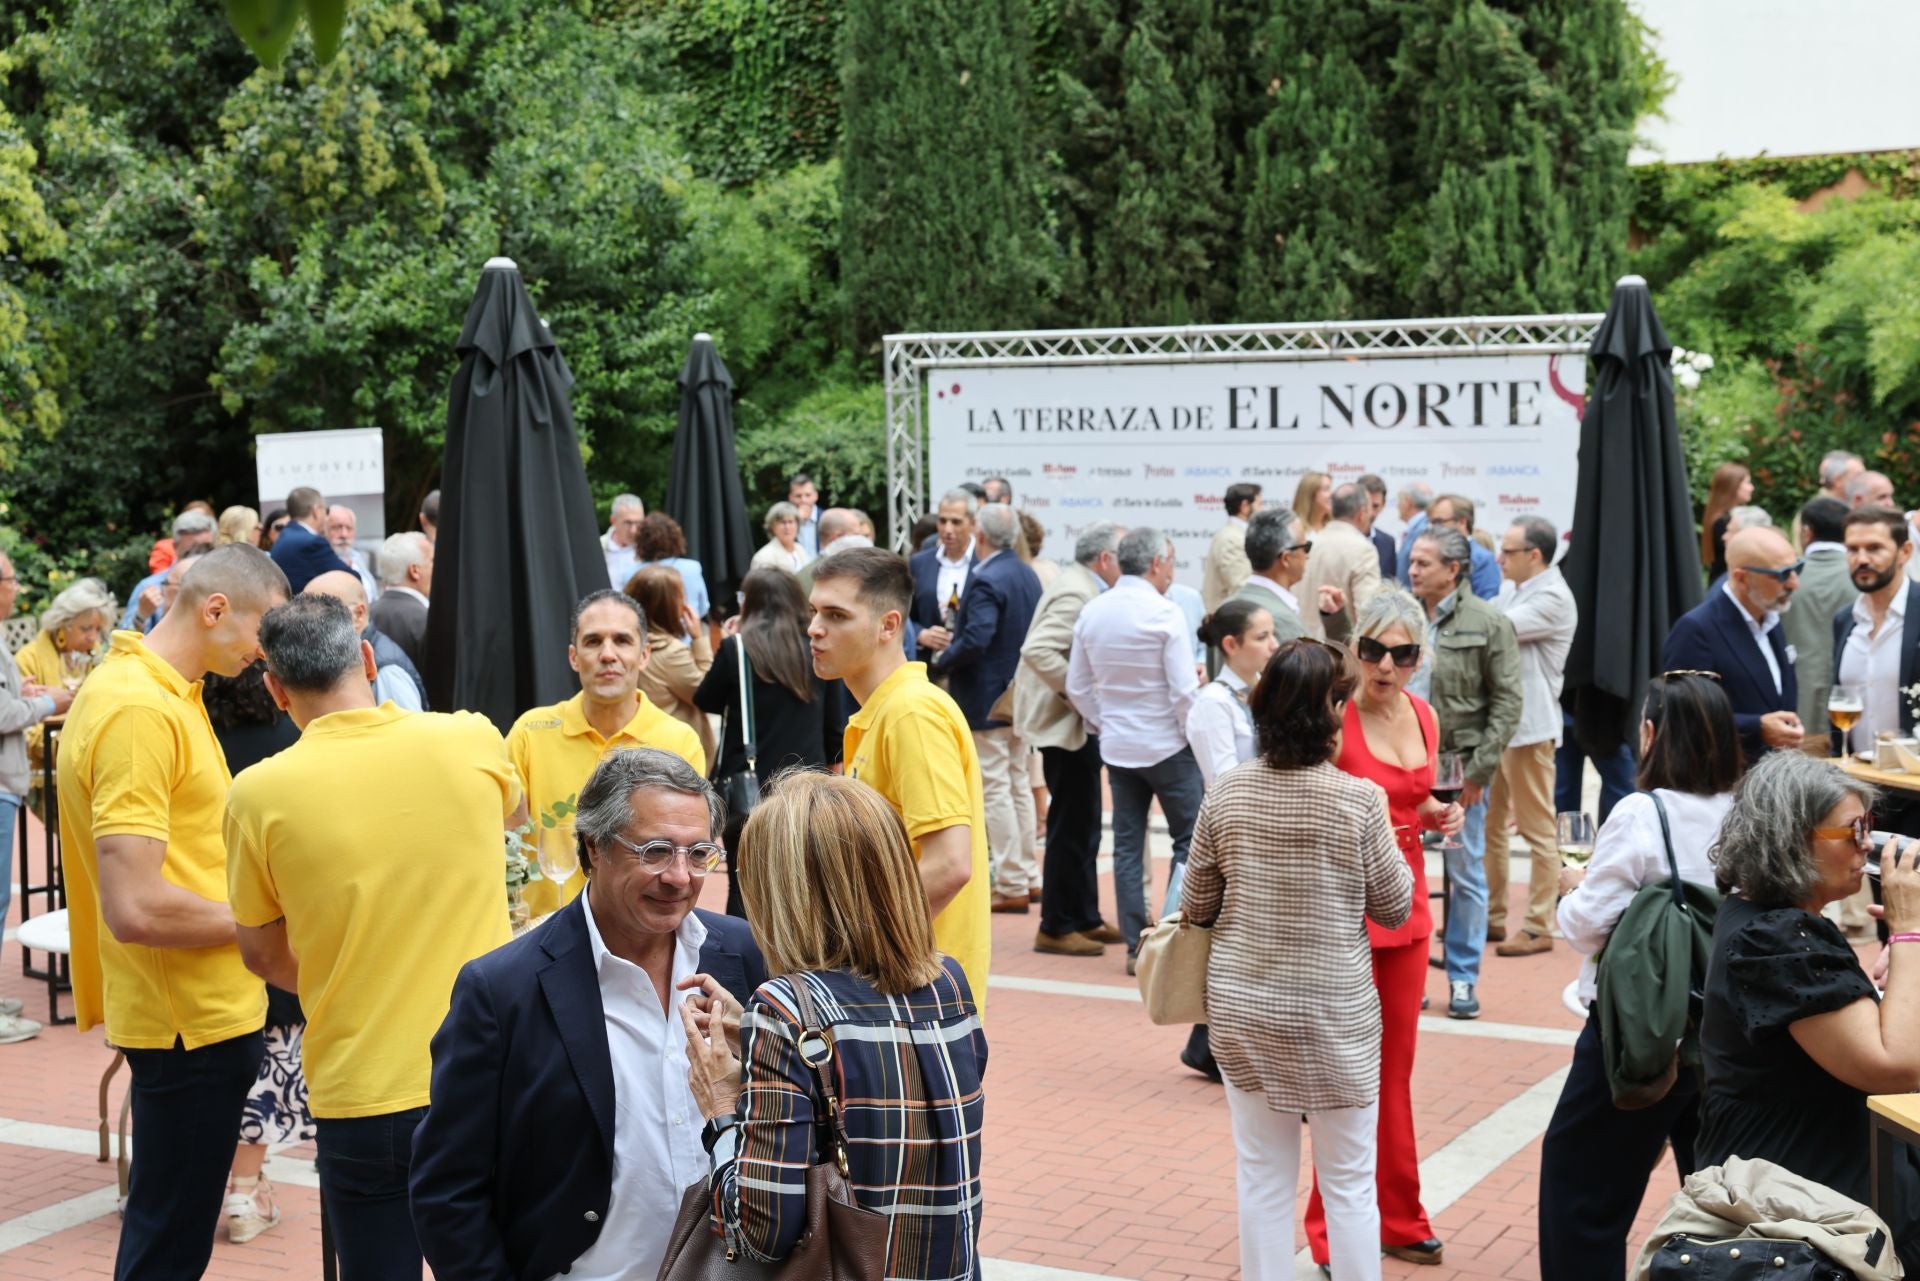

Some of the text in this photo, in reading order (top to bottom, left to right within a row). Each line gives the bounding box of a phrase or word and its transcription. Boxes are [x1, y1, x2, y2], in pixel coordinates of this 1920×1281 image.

[967, 379, 1542, 432] LA TERRAZA DE EL NORTE
